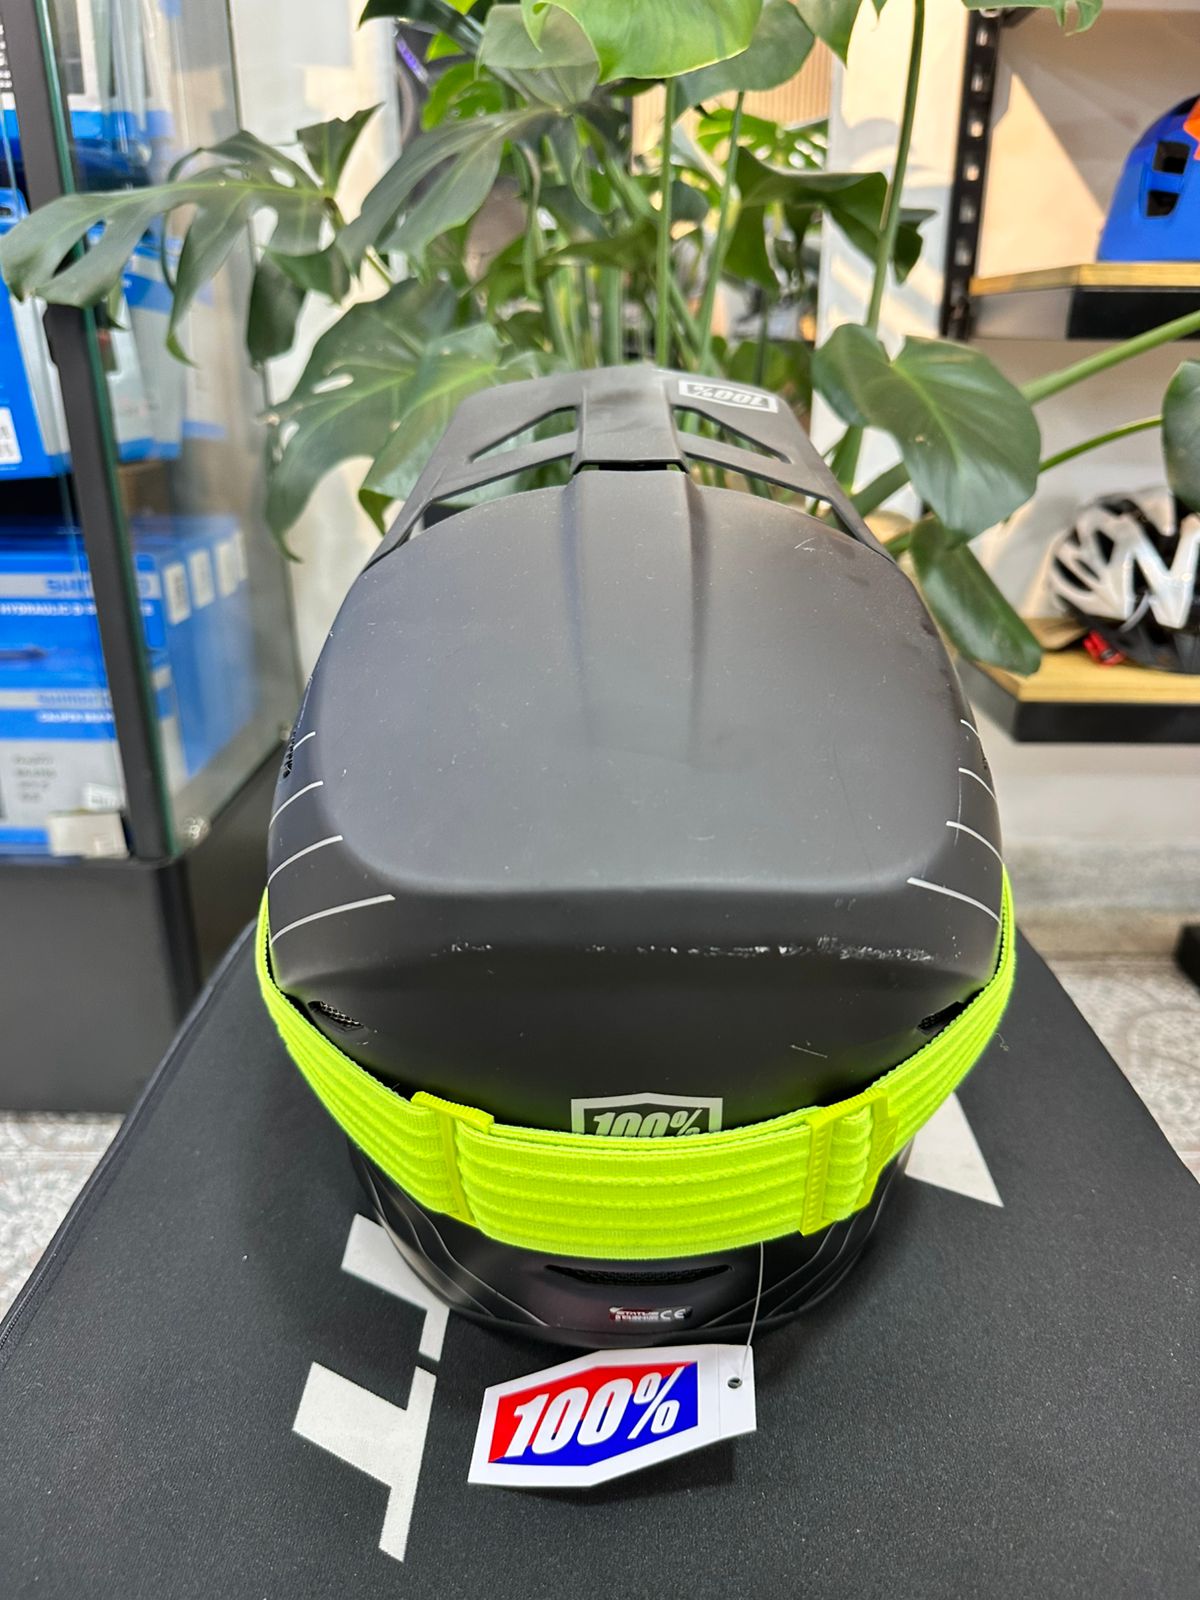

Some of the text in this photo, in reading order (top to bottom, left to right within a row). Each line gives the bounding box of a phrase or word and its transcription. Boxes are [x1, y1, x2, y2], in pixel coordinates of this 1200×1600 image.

[693, 386, 764, 405] 100%
[593, 1108, 703, 1137] 100%
[503, 1366, 686, 1458] 100%
